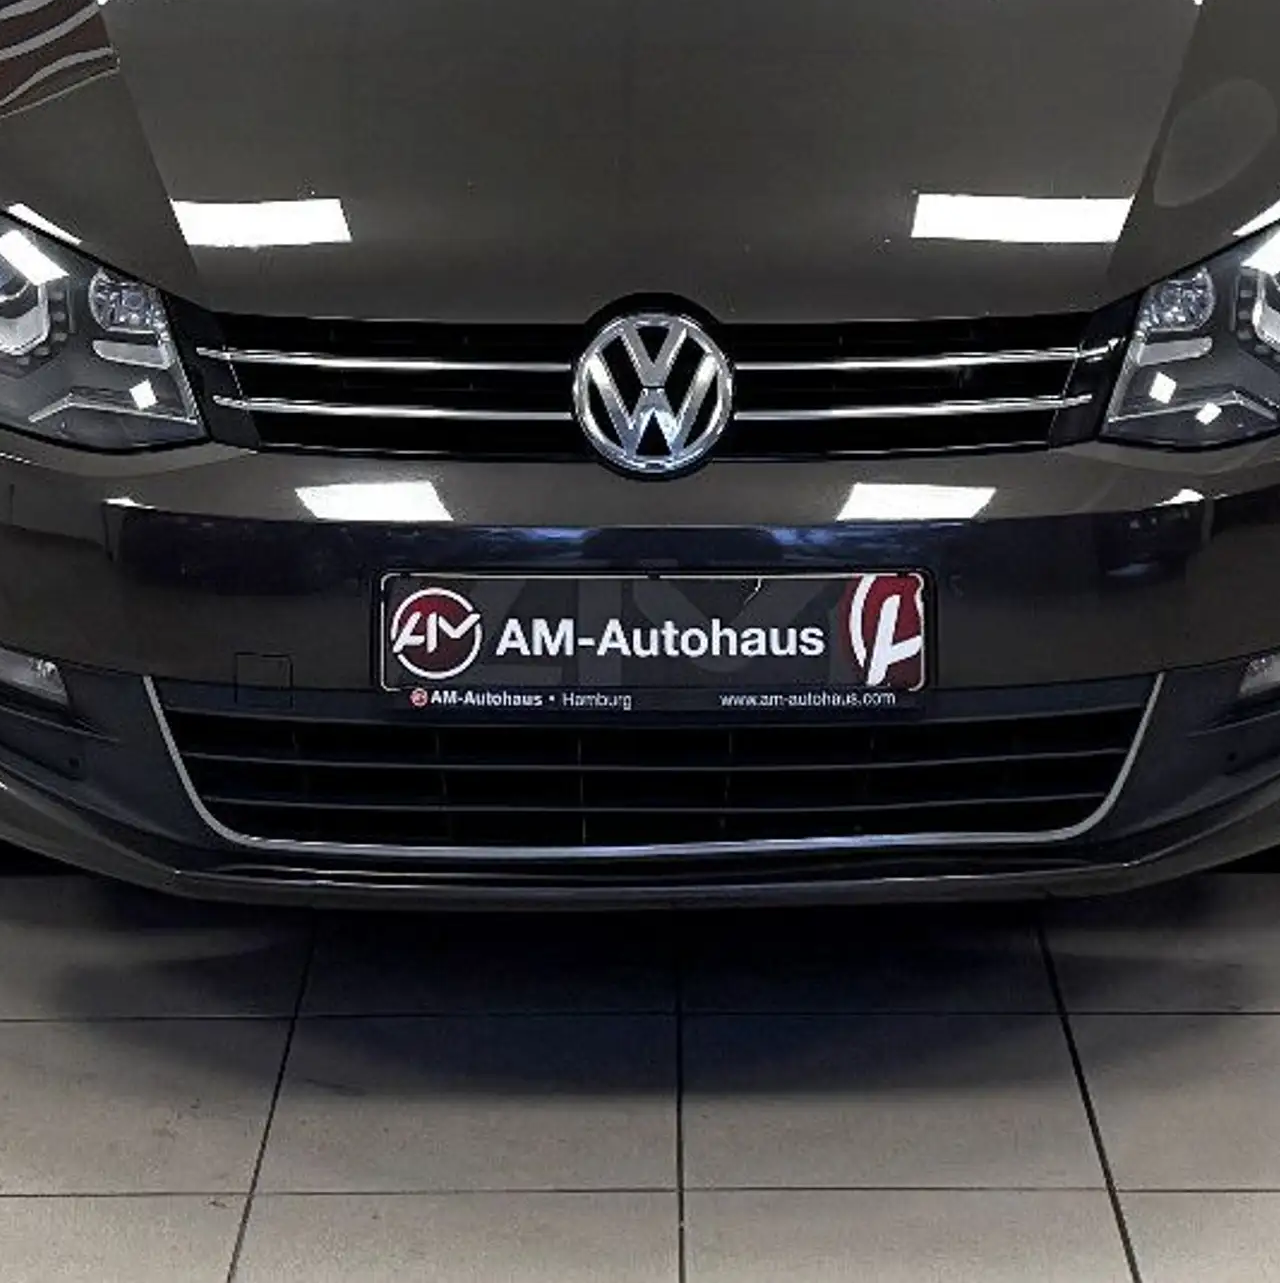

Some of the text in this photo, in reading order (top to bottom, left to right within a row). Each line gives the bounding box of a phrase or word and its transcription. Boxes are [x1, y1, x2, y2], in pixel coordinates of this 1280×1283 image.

[494, 618, 826, 658] AM-Autohaus
[430, 689, 543, 707] AM-Autohaus
[561, 691, 632, 711] Hamburg
[719, 691, 896, 708] www.am-autohaus.com
